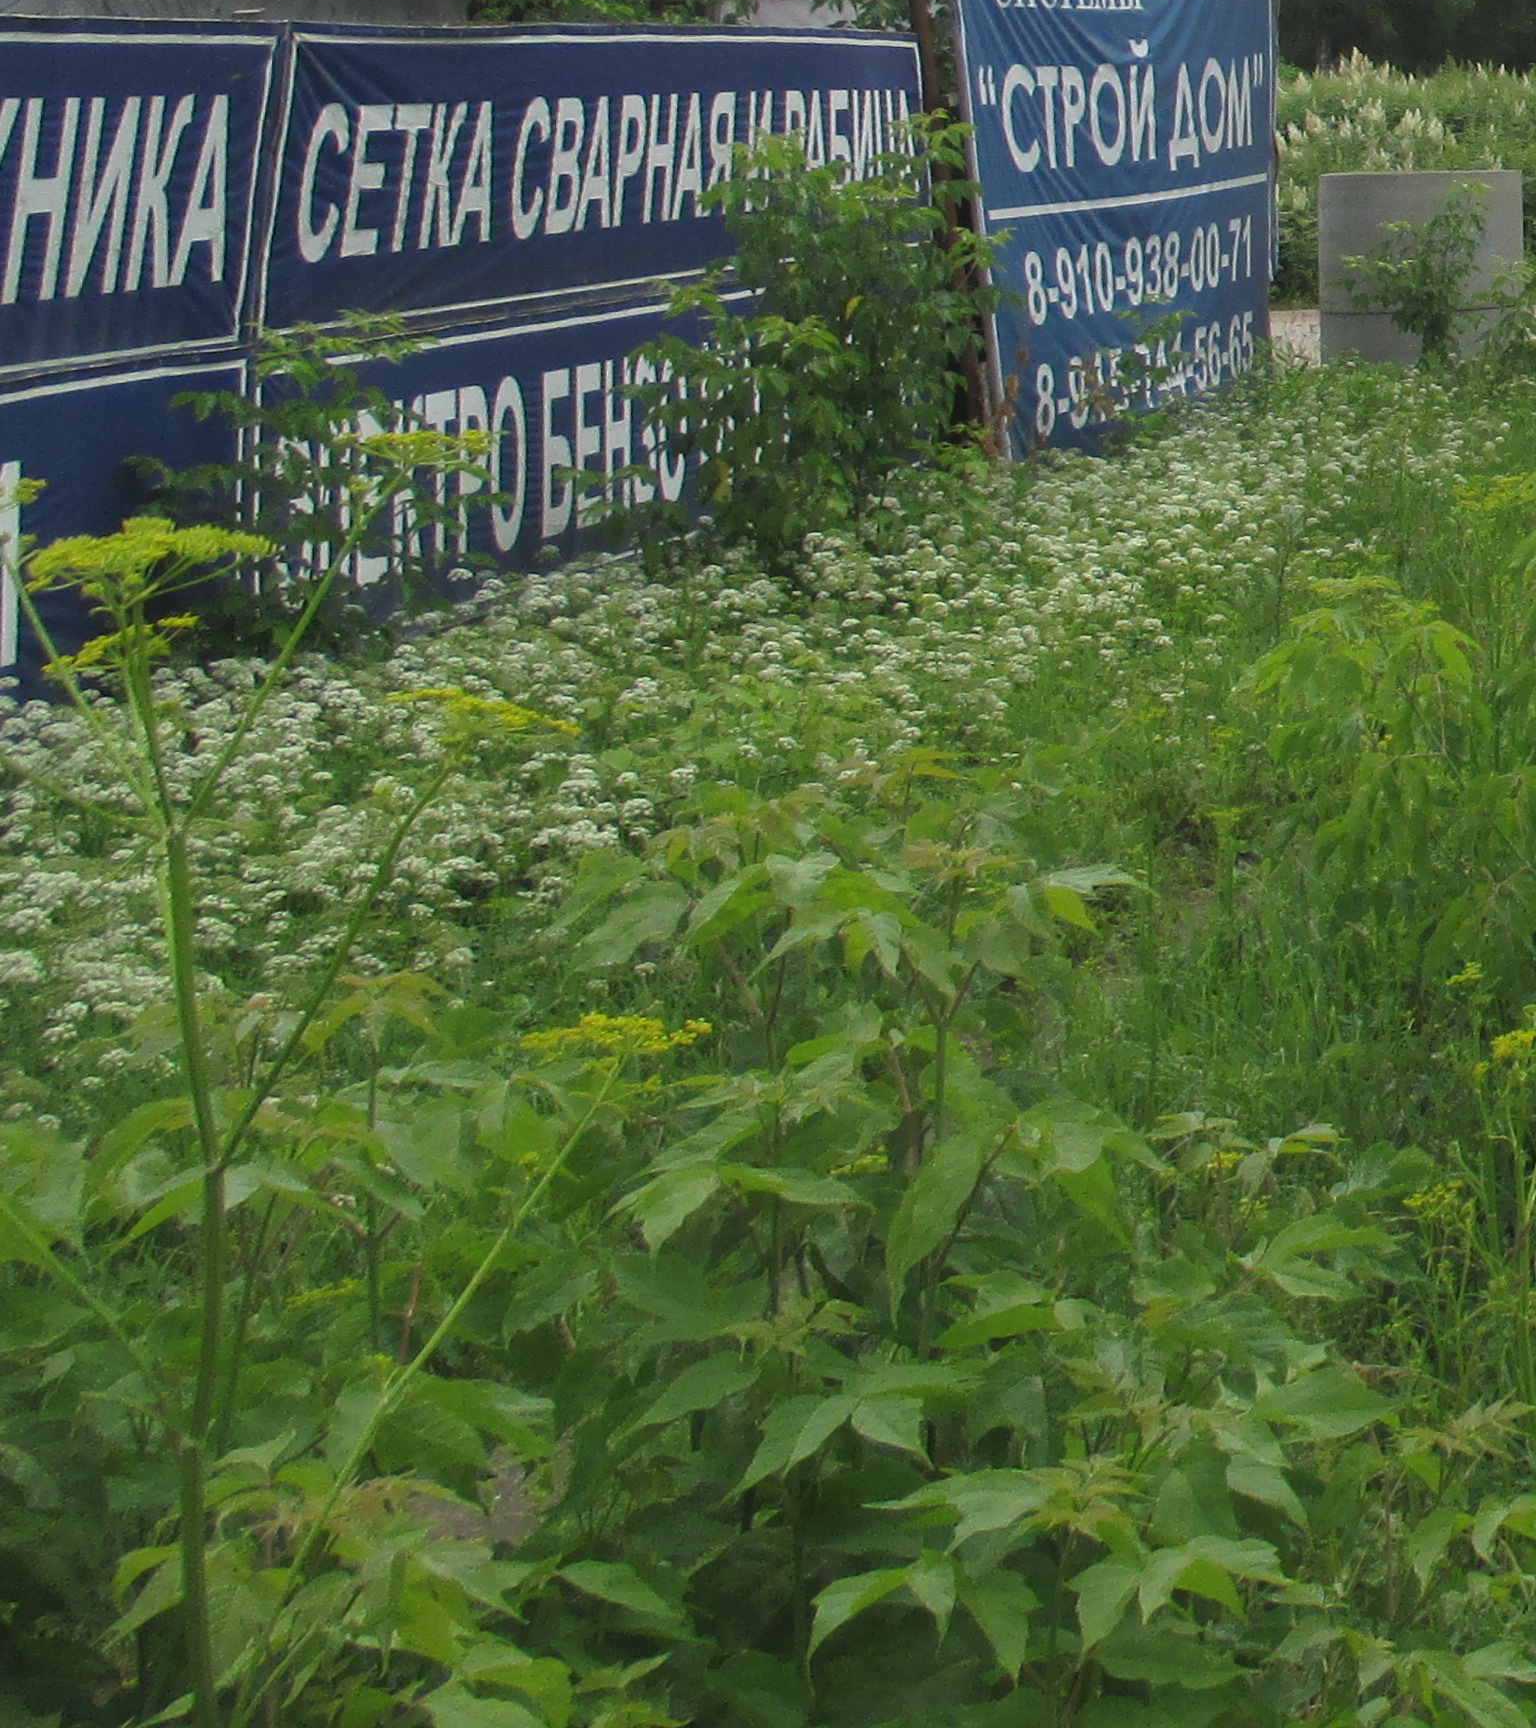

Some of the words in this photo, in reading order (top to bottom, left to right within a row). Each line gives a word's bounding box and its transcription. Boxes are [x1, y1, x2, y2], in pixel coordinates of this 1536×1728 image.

[0, 93, 229, 306] НИКА
[299, 98, 493, 263] СЕТКА
[511, 90, 736, 240] СВАРНАЯ
[1023, 213, 1253, 327] 8-910-938-00-71
